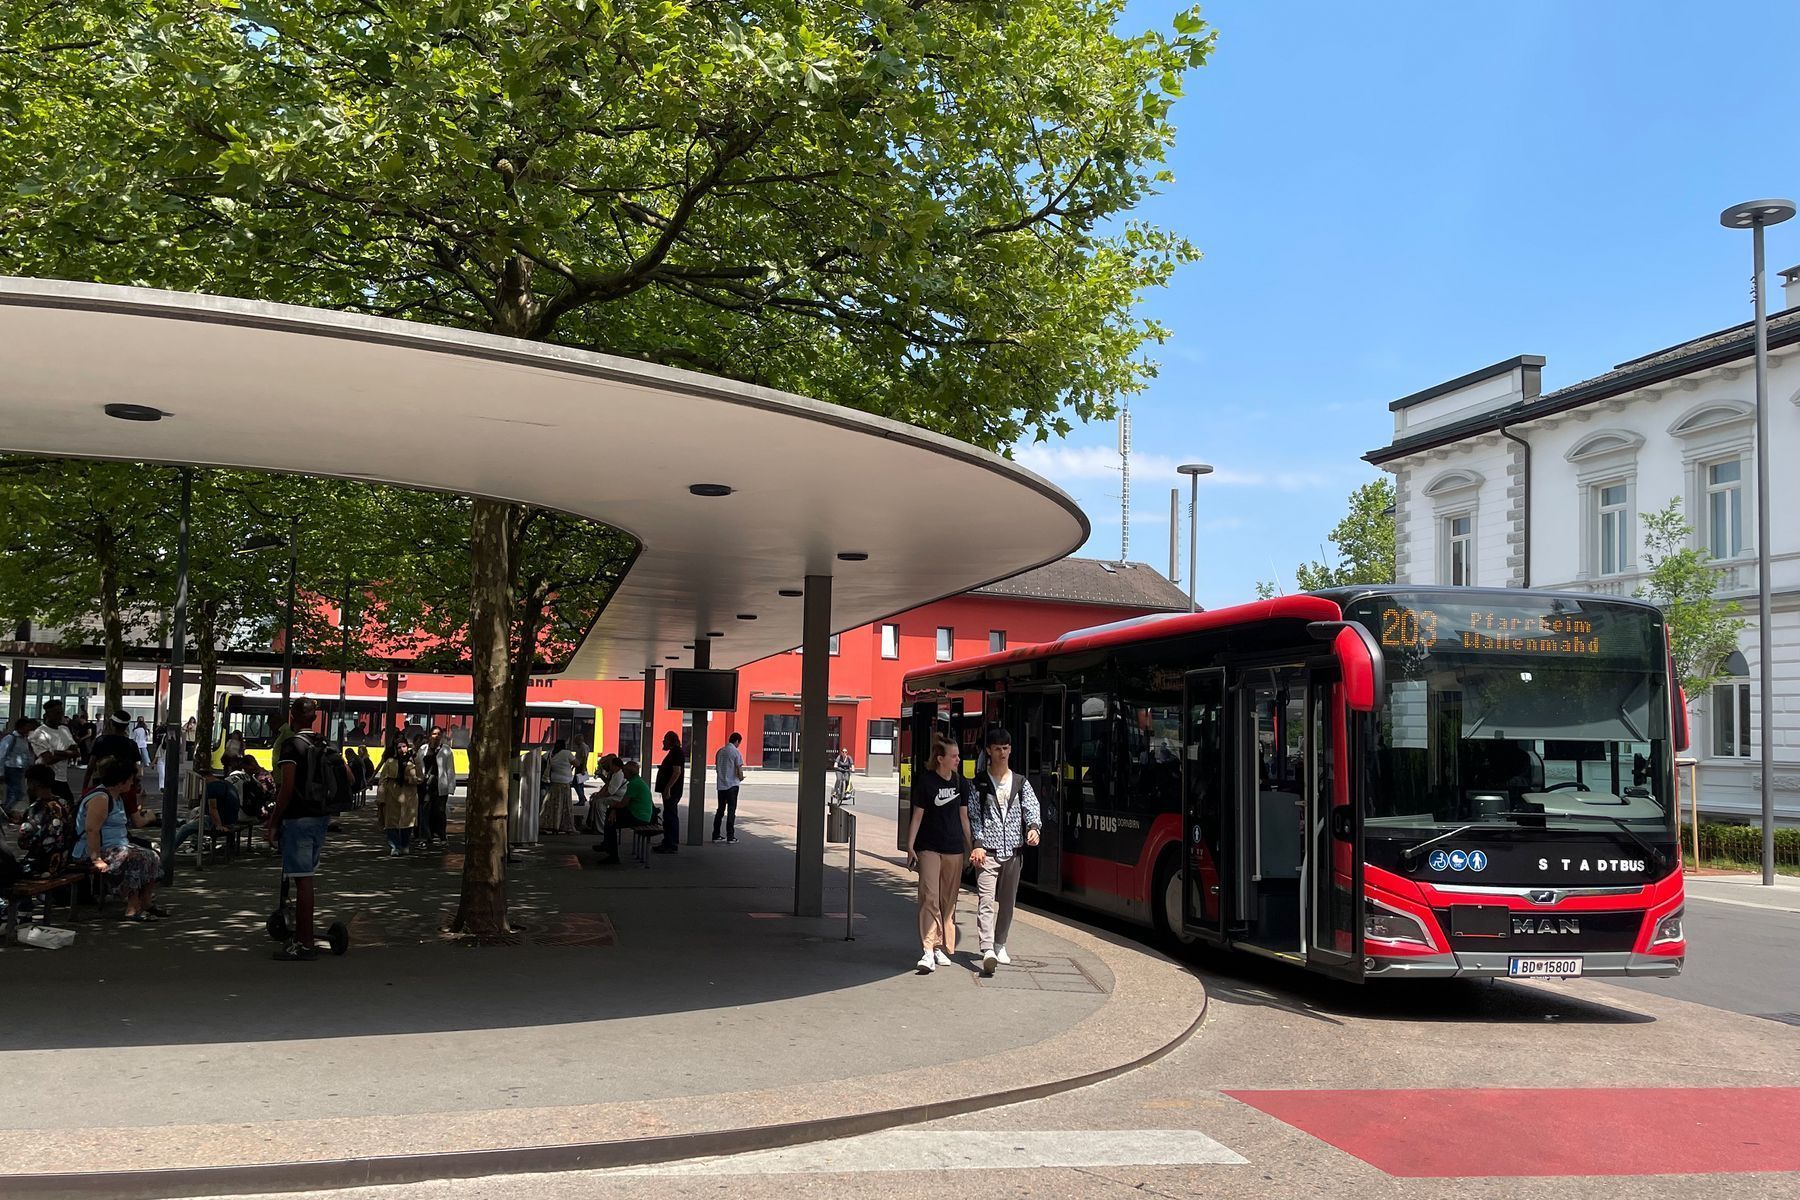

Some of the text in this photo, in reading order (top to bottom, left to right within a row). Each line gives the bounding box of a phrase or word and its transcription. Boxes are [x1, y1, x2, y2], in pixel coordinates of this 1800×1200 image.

[1382, 608, 1591, 647] 203 Pfarrheim
[1464, 632, 1599, 653] Wallenmahd
[528, 678, 553, 687] ann
[938, 787, 957, 798] NIKE
[1066, 812, 1118, 833] TADTBUS
[1512, 918, 1581, 934] MAN
